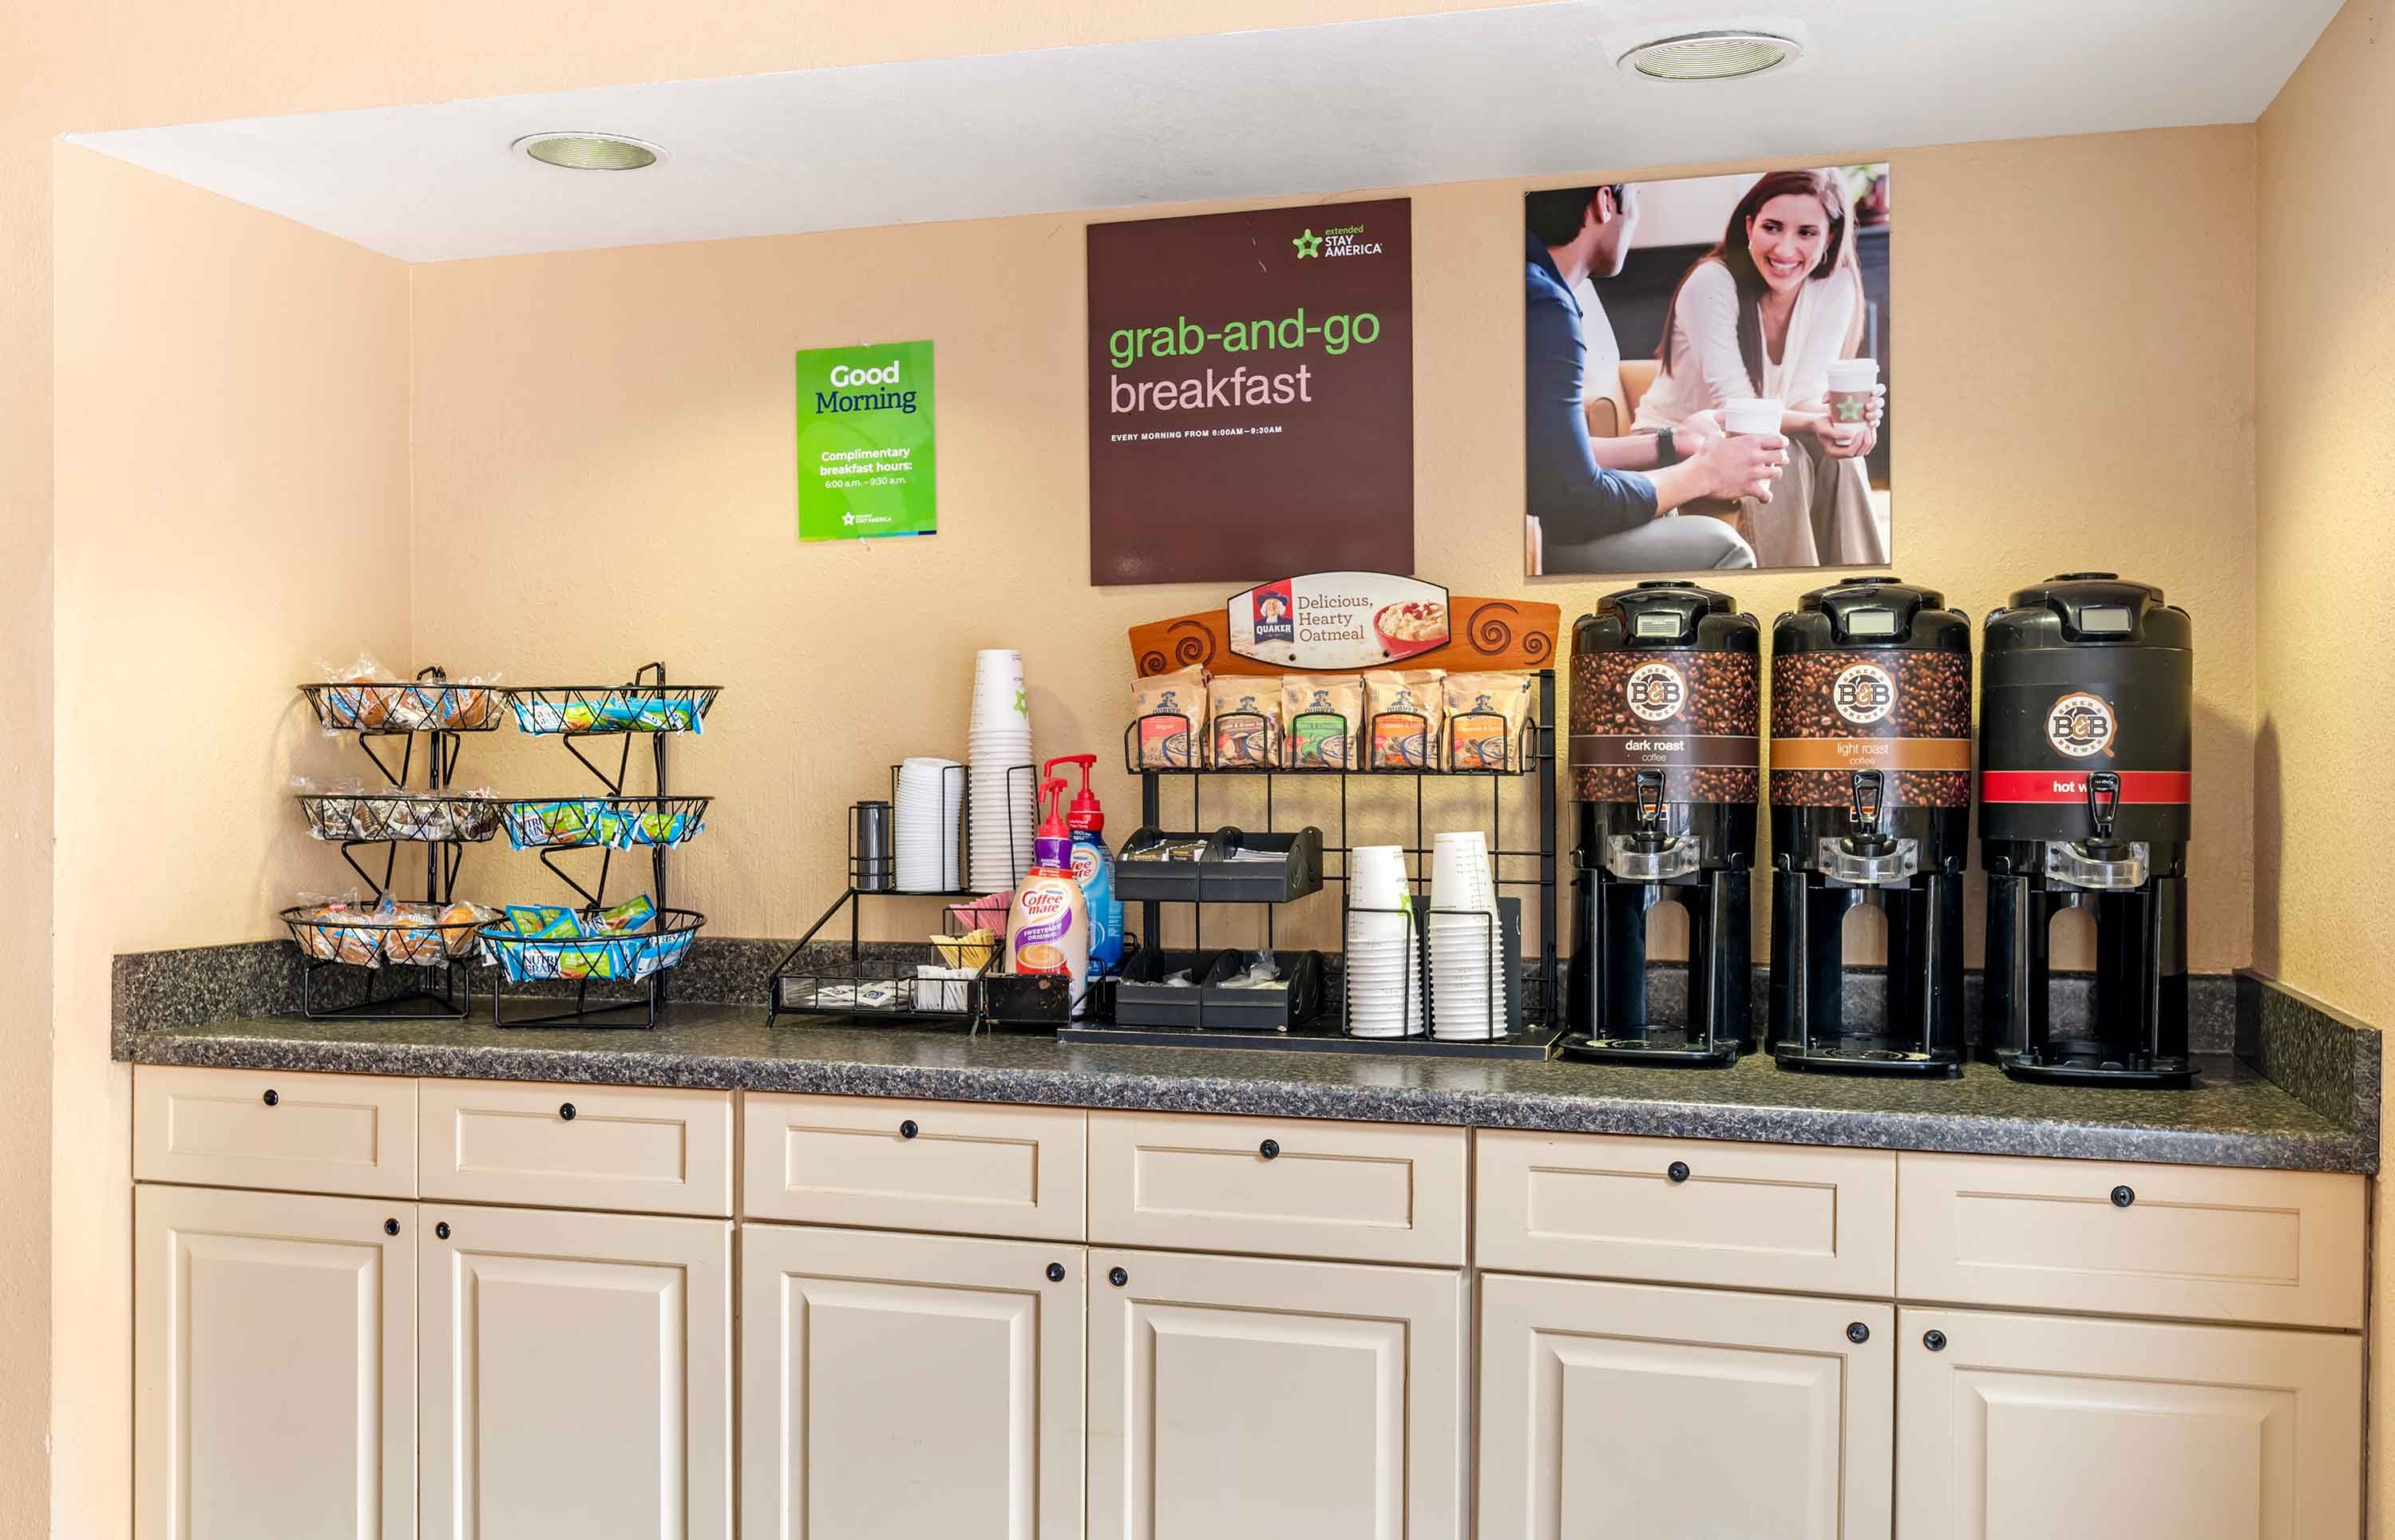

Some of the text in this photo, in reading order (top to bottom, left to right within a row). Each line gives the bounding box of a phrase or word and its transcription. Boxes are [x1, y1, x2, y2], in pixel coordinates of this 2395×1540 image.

[1325, 224, 1364, 236] extended
[1325, 235, 1353, 247] STAY
[1325, 243, 1382, 257] AMERICA
[1110, 307, 1380, 369] grab-and-go
[830, 360, 900, 388] Good
[1110, 364, 1312, 413] breakfast
[815, 386, 916, 414] Morning
[1141, 431, 1182, 440] MORNING
[1185, 430, 1209, 438] FROM
[821, 448, 910, 461] Complimentary
[820, 461, 913, 476] breakfast hours:
[825, 480, 843, 489] 6:00
[1297, 594, 1373, 610] Delicious,
[1299, 612, 1352, 627] Hearty
[1256, 624, 1292, 635] QUAKER
[1299, 625, 1364, 642] Oatmeal
[1631, 680, 1680, 704] B&B
[1838, 682, 1890, 705] B&B
[2053, 715, 2108, 739] B&B
[1625, 740, 1684, 750] dark roast
[1837, 742, 1889, 756] light roast
[1641, 753, 1666, 762] coffee
[1849, 756, 1876, 765] coffee
[2053, 781, 2075, 793] hot
[1022, 890, 1063, 908] Coffee
[1028, 905, 1059, 915] mate
